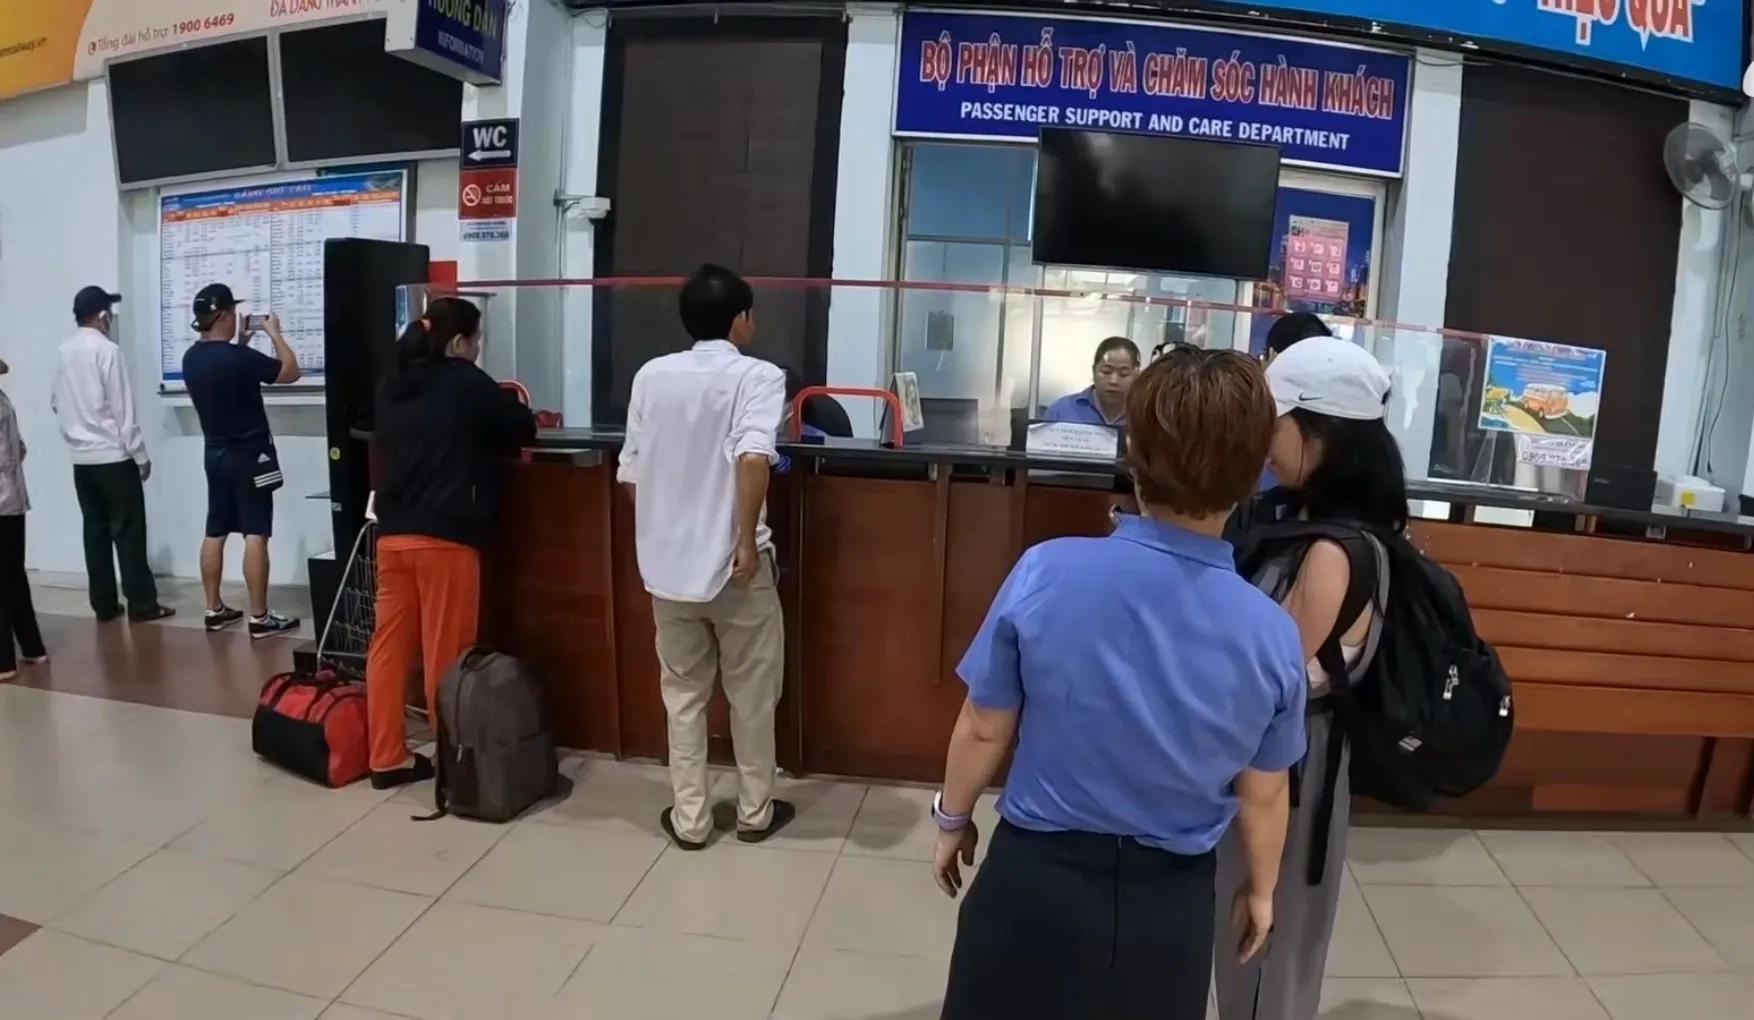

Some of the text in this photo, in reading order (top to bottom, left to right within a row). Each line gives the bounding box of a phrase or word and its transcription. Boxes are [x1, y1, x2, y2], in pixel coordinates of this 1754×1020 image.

[172, 18, 201, 34] 1900
[203, 12, 235, 30] 6469
[920, 27, 1394, 120] BỘ PHẬN HỖ TRỢ VÀ CHĂM SÓC HÀNH KHÁCH
[473, 126, 507, 149] WC
[960, 101, 1350, 150] PASSENGER SUPPORT AND CARE DEPARTMENT
